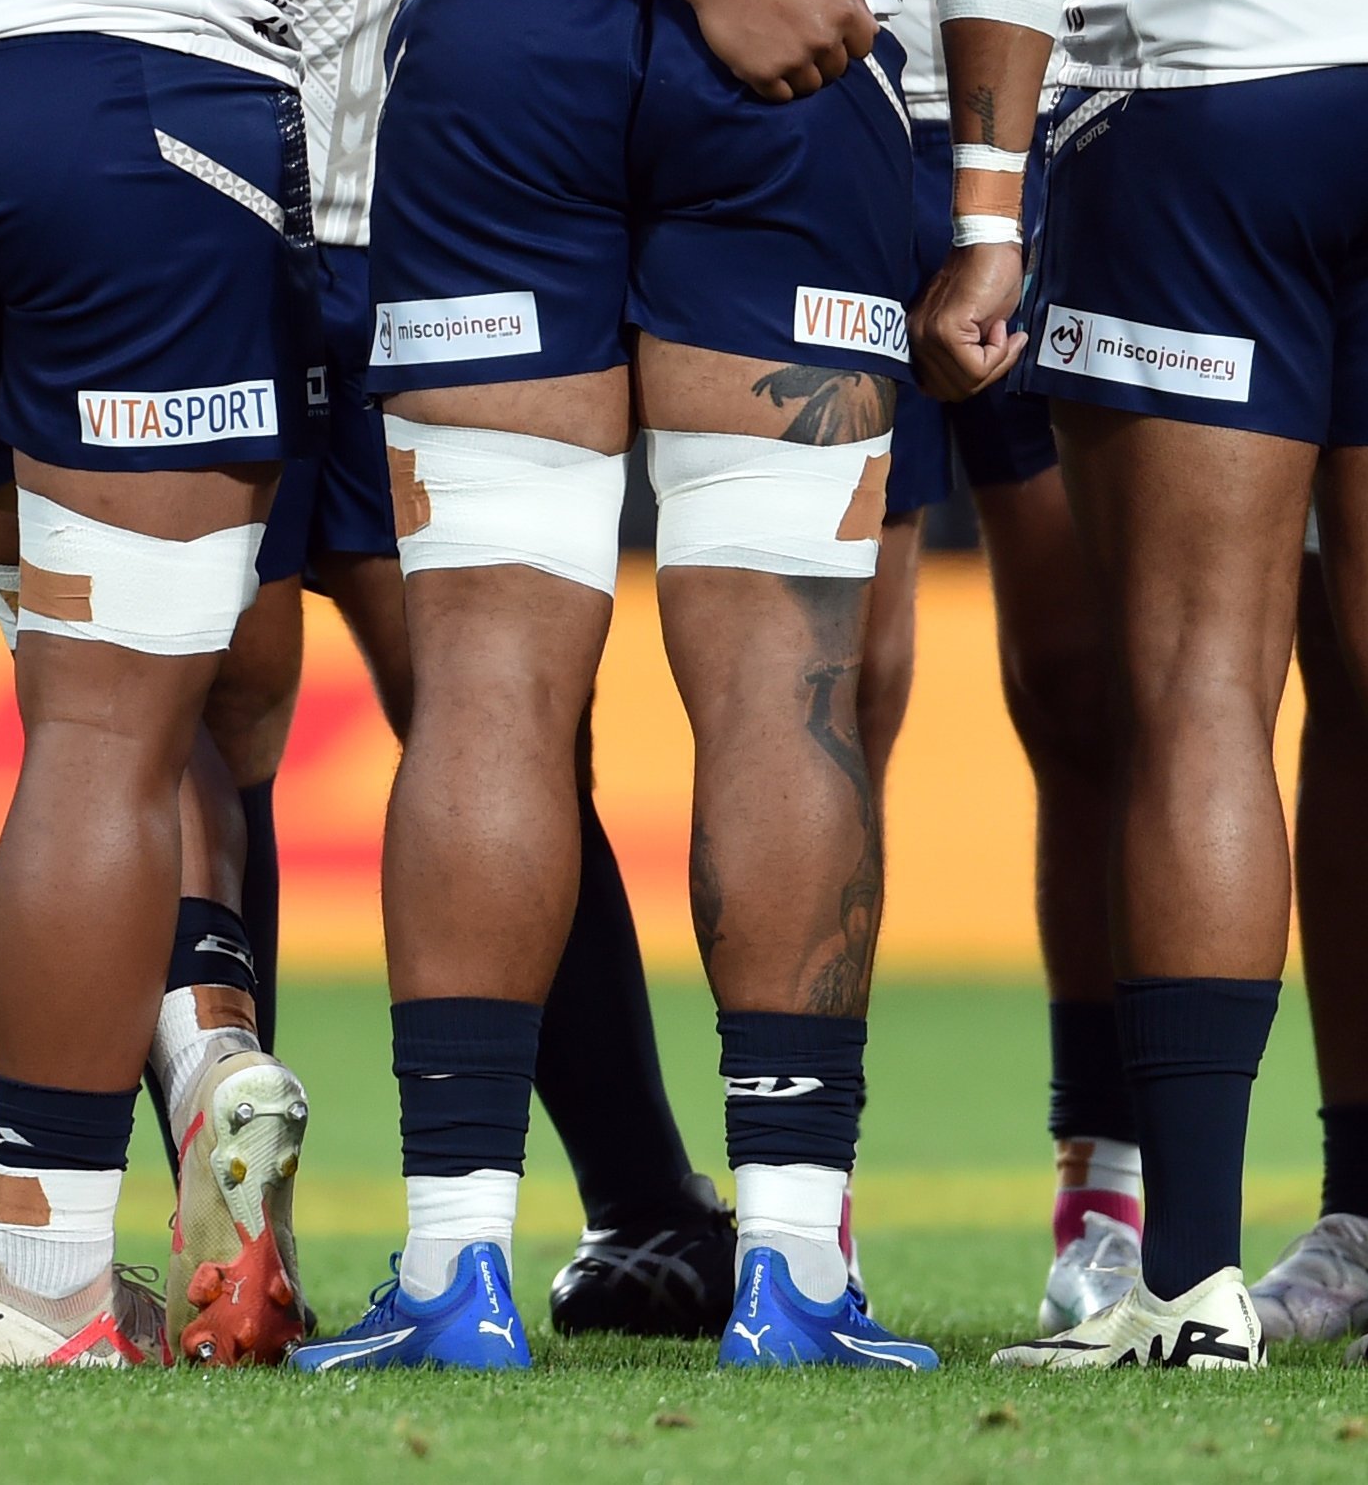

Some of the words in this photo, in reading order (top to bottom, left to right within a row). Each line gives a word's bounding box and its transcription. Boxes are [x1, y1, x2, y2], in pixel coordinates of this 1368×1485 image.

[397, 314, 522, 343] miscojoinery
[803, 294, 909, 354] VITASPO
[1096, 336, 1236, 382] miscojoinery
[85, 386, 269, 440] VITASPORT
[747, 1263, 765, 1319] ULTRA
